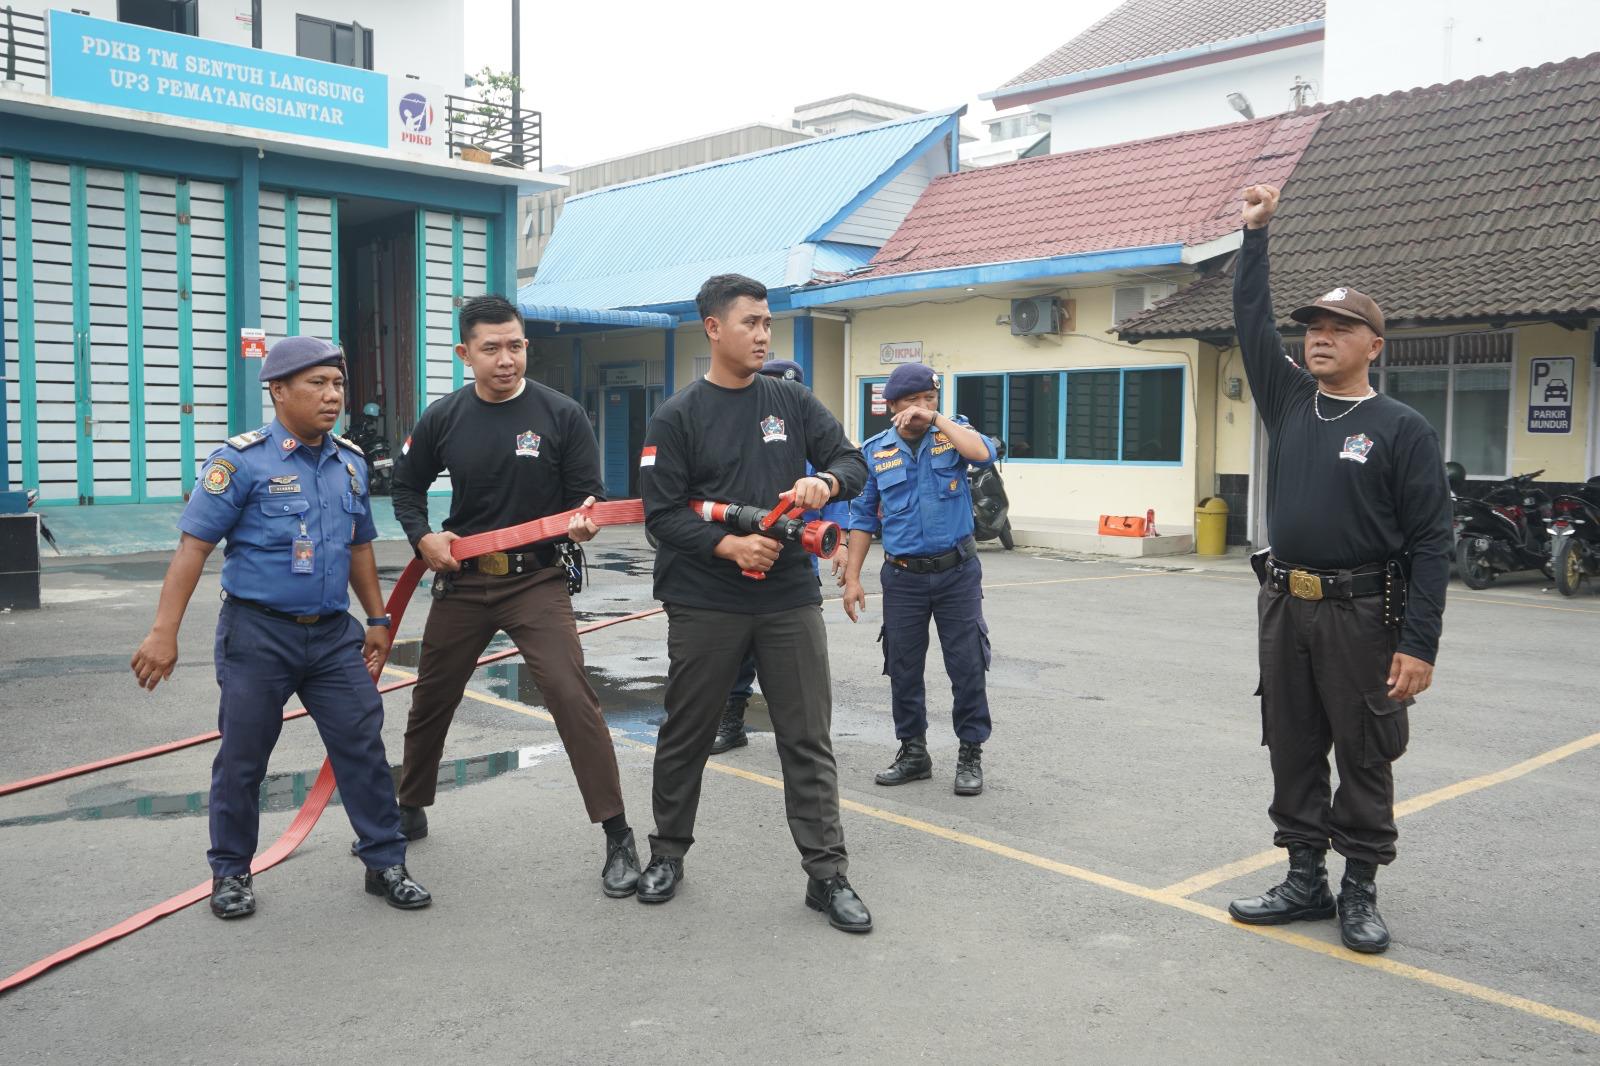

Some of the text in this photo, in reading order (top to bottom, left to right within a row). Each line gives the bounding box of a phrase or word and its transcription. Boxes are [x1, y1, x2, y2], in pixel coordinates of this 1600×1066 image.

[81, 35, 365, 104] PDKB TM SENTUH LANGSUNG
[109, 68, 344, 125] UP3 PEMATANGSIANTAR
[401, 131, 432, 146] PDKB
[1533, 362, 1550, 386] P
[1533, 410, 1567, 419] PARKIR
[1530, 420, 1569, 429] MUNDUR
